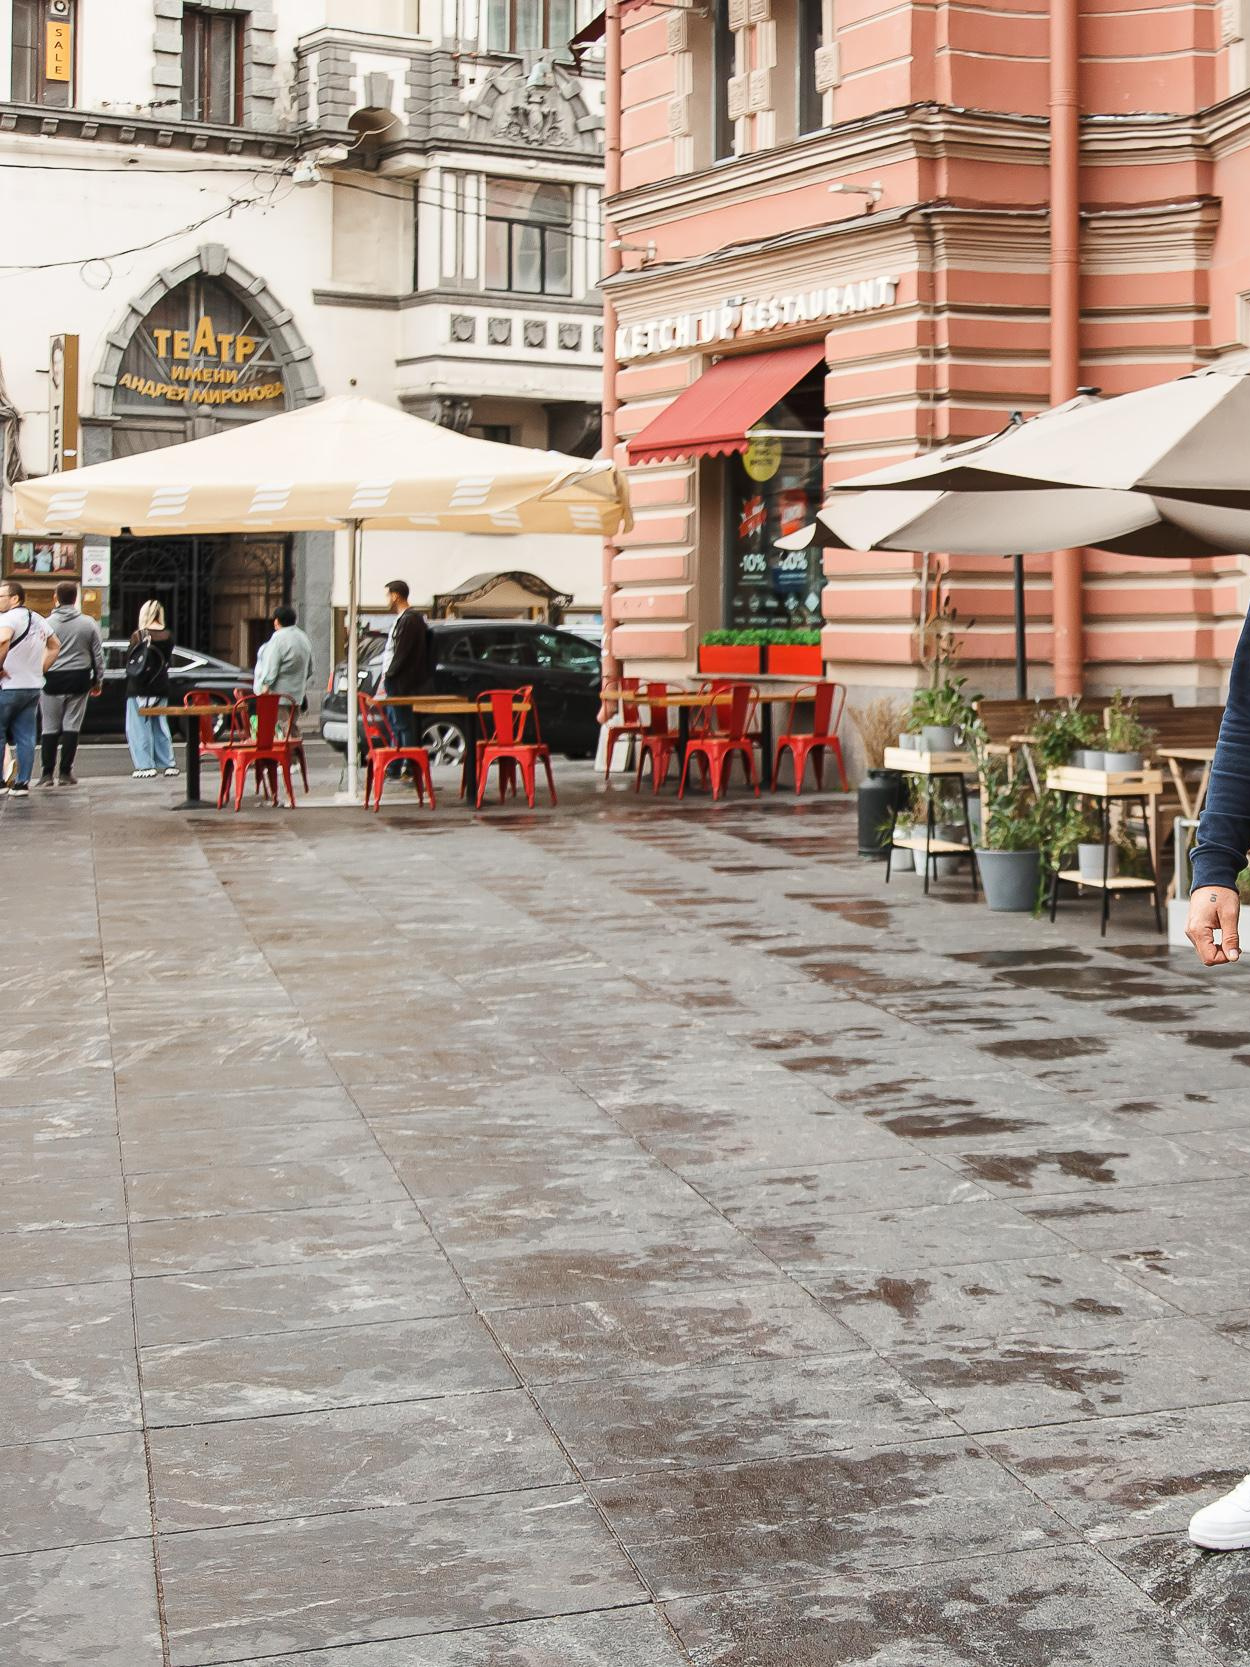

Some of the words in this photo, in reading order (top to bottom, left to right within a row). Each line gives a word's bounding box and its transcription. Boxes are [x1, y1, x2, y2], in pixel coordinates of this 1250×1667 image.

[54, 28, 64, 75] SALE
[153, 316, 257, 363] ТЕАТР
[615, 313, 694, 360] KETCH
[742, 275, 897, 333] RESTAURANT
[119, 372, 190, 401] АНДРЕЯ
[191, 382, 287, 405] МИРОНОВА
[170, 365, 240, 384] ИМЕНИ
